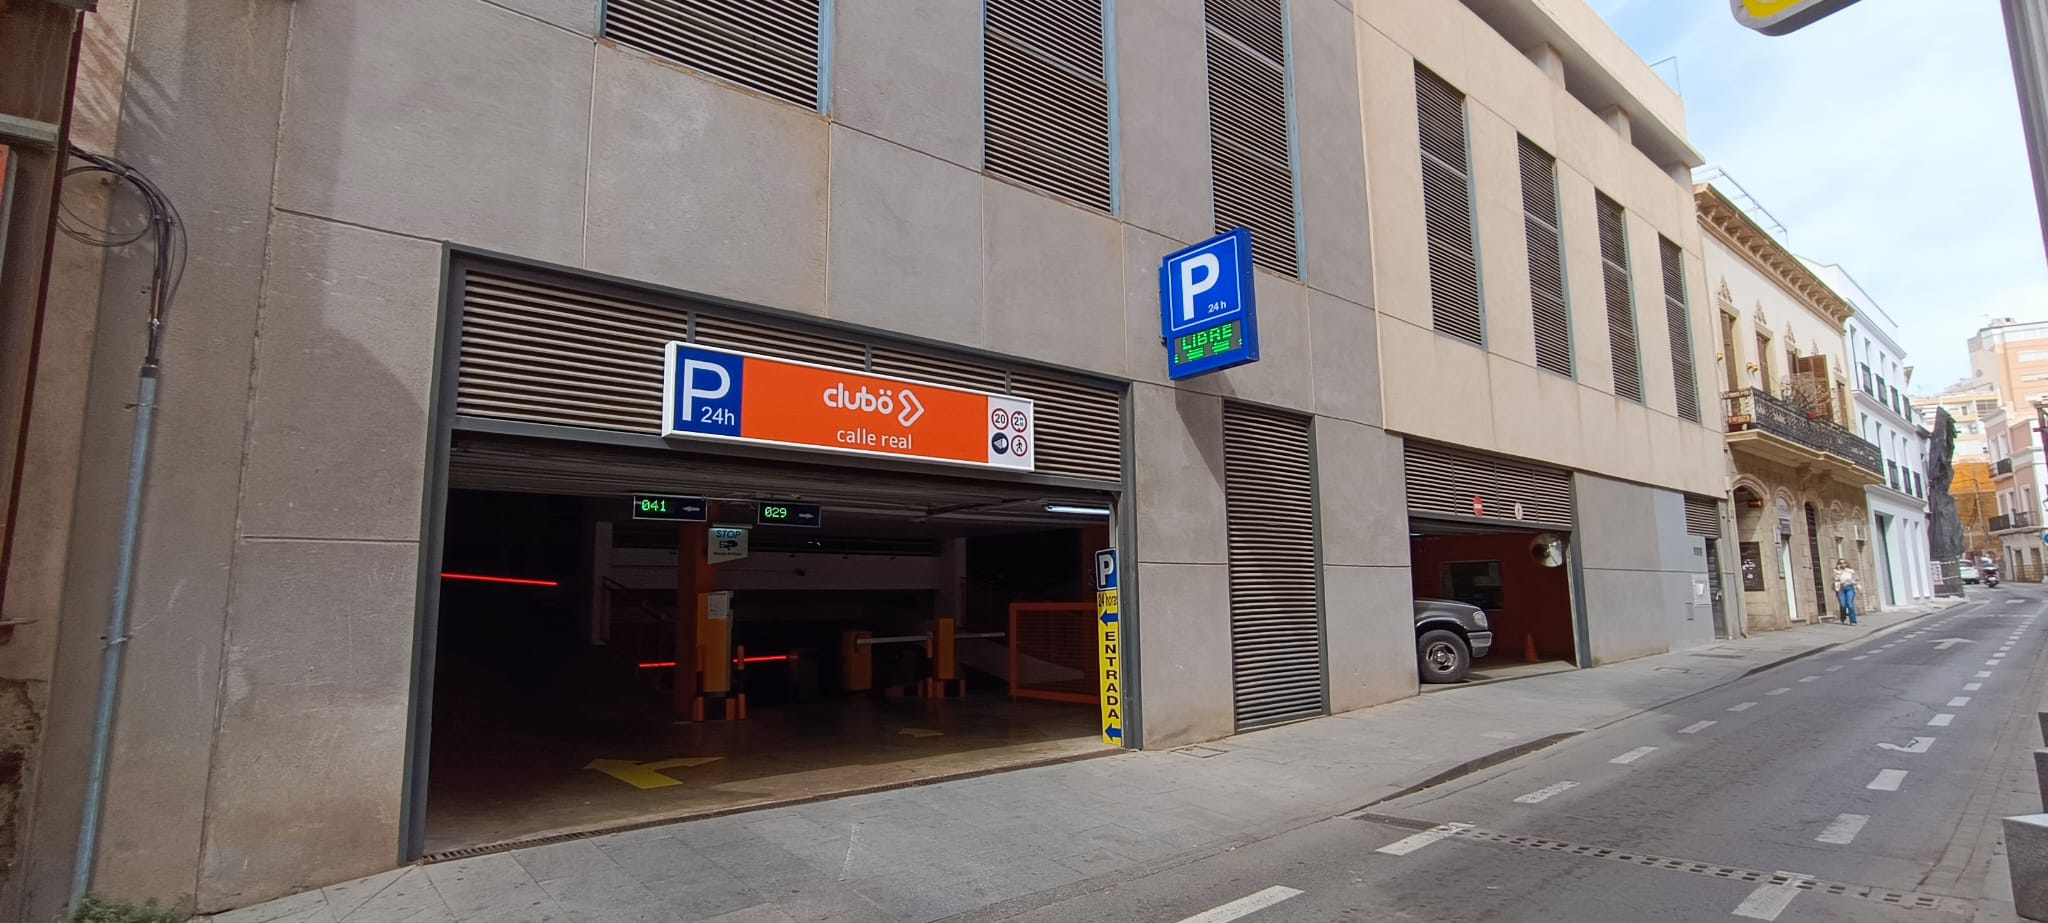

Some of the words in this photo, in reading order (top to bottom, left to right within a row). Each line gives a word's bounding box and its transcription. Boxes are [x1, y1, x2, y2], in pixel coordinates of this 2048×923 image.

[1181, 253, 1220, 321] P
[1208, 302, 1219, 313] 24
[1220, 300, 1227, 310] h
[1182, 323, 1232, 350] LIBRE
[682, 358, 731, 422] P
[823, 382, 894, 415] clubö
[701, 406, 735, 426] 24h
[995, 413, 1006, 425] 20
[837, 428, 877, 446] calle
[881, 433, 912, 450] real
[641, 499, 666, 512] 041
[764, 506, 787, 518] 029
[716, 529, 741, 539] STOP
[1099, 554, 1114, 586] P
[1105, 631, 1120, 720] ENTRADA
